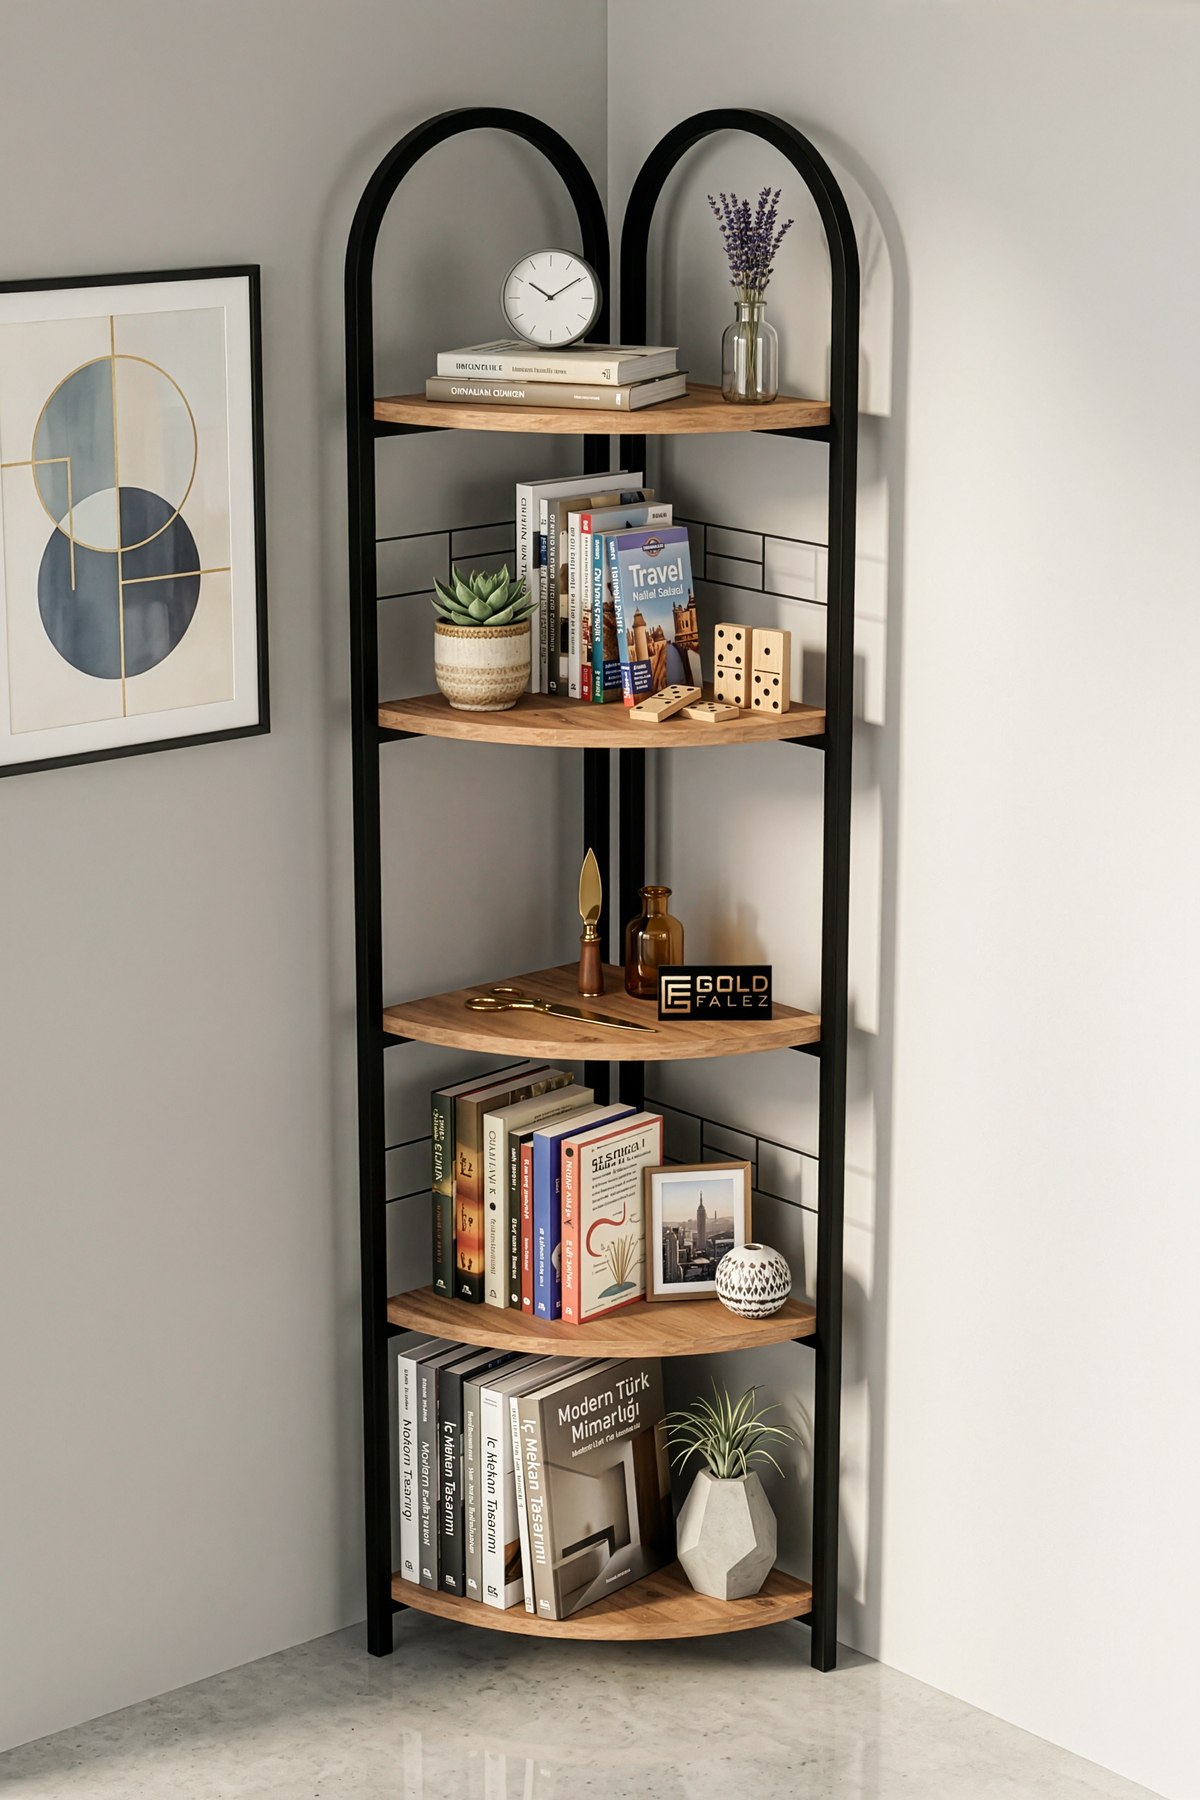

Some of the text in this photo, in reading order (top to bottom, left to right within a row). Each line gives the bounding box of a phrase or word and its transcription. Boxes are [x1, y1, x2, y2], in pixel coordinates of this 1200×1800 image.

[628, 557, 683, 588] Travel
[696, 975, 769, 993] GOLD
[696, 995, 768, 1007] FALEZ
[558, 1372, 650, 1426] Modern Türk
[571, 1397, 640, 1444] Mimarlığı
[525, 1438, 541, 1490] Mekan
